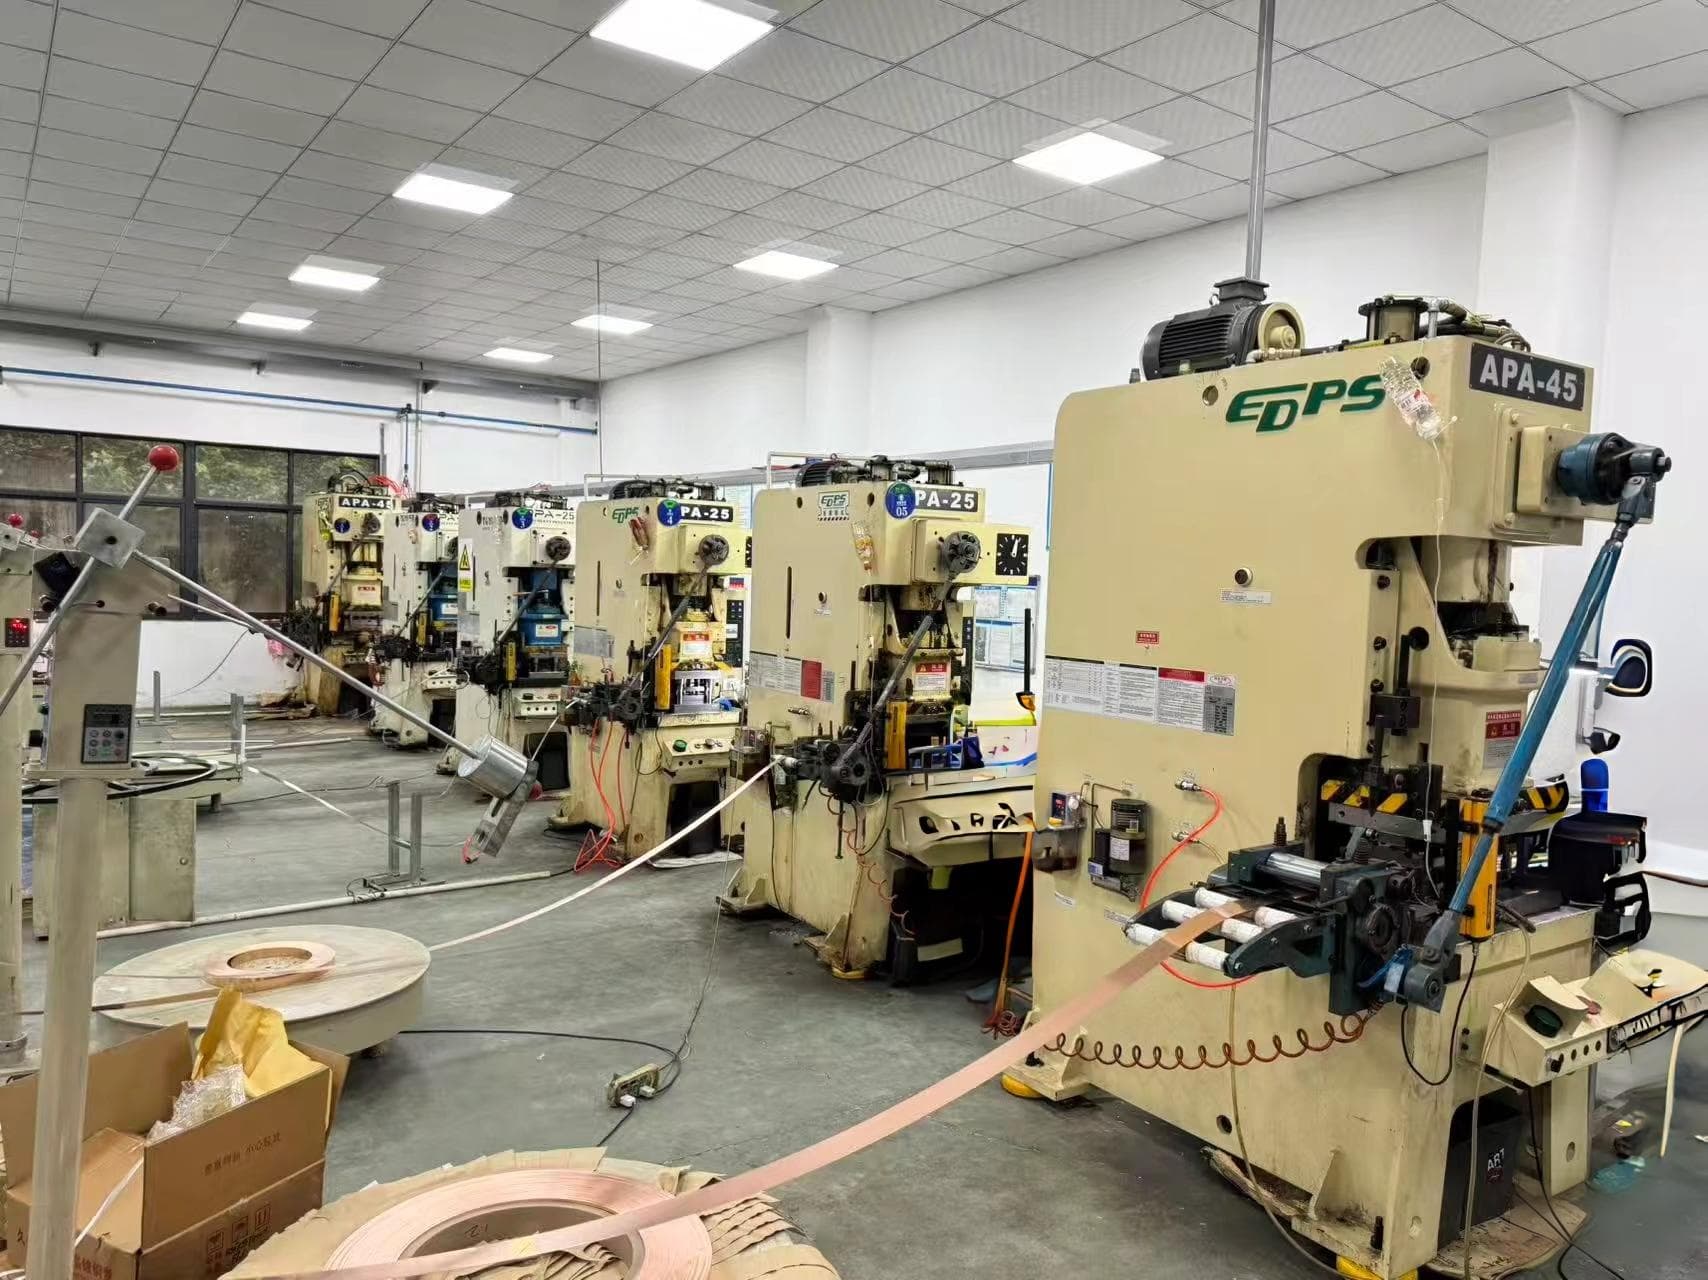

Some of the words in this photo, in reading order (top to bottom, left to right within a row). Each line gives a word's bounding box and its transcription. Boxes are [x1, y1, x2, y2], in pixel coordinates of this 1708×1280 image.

[1480, 353, 1577, 402] APA-45
[1225, 374, 1386, 433] EDPS
[914, 490, 976, 509] PA-25
[534, 509, 575, 520] PA-25
[680, 505, 730, 519] PA-25
[895, 507, 908, 517] 05
